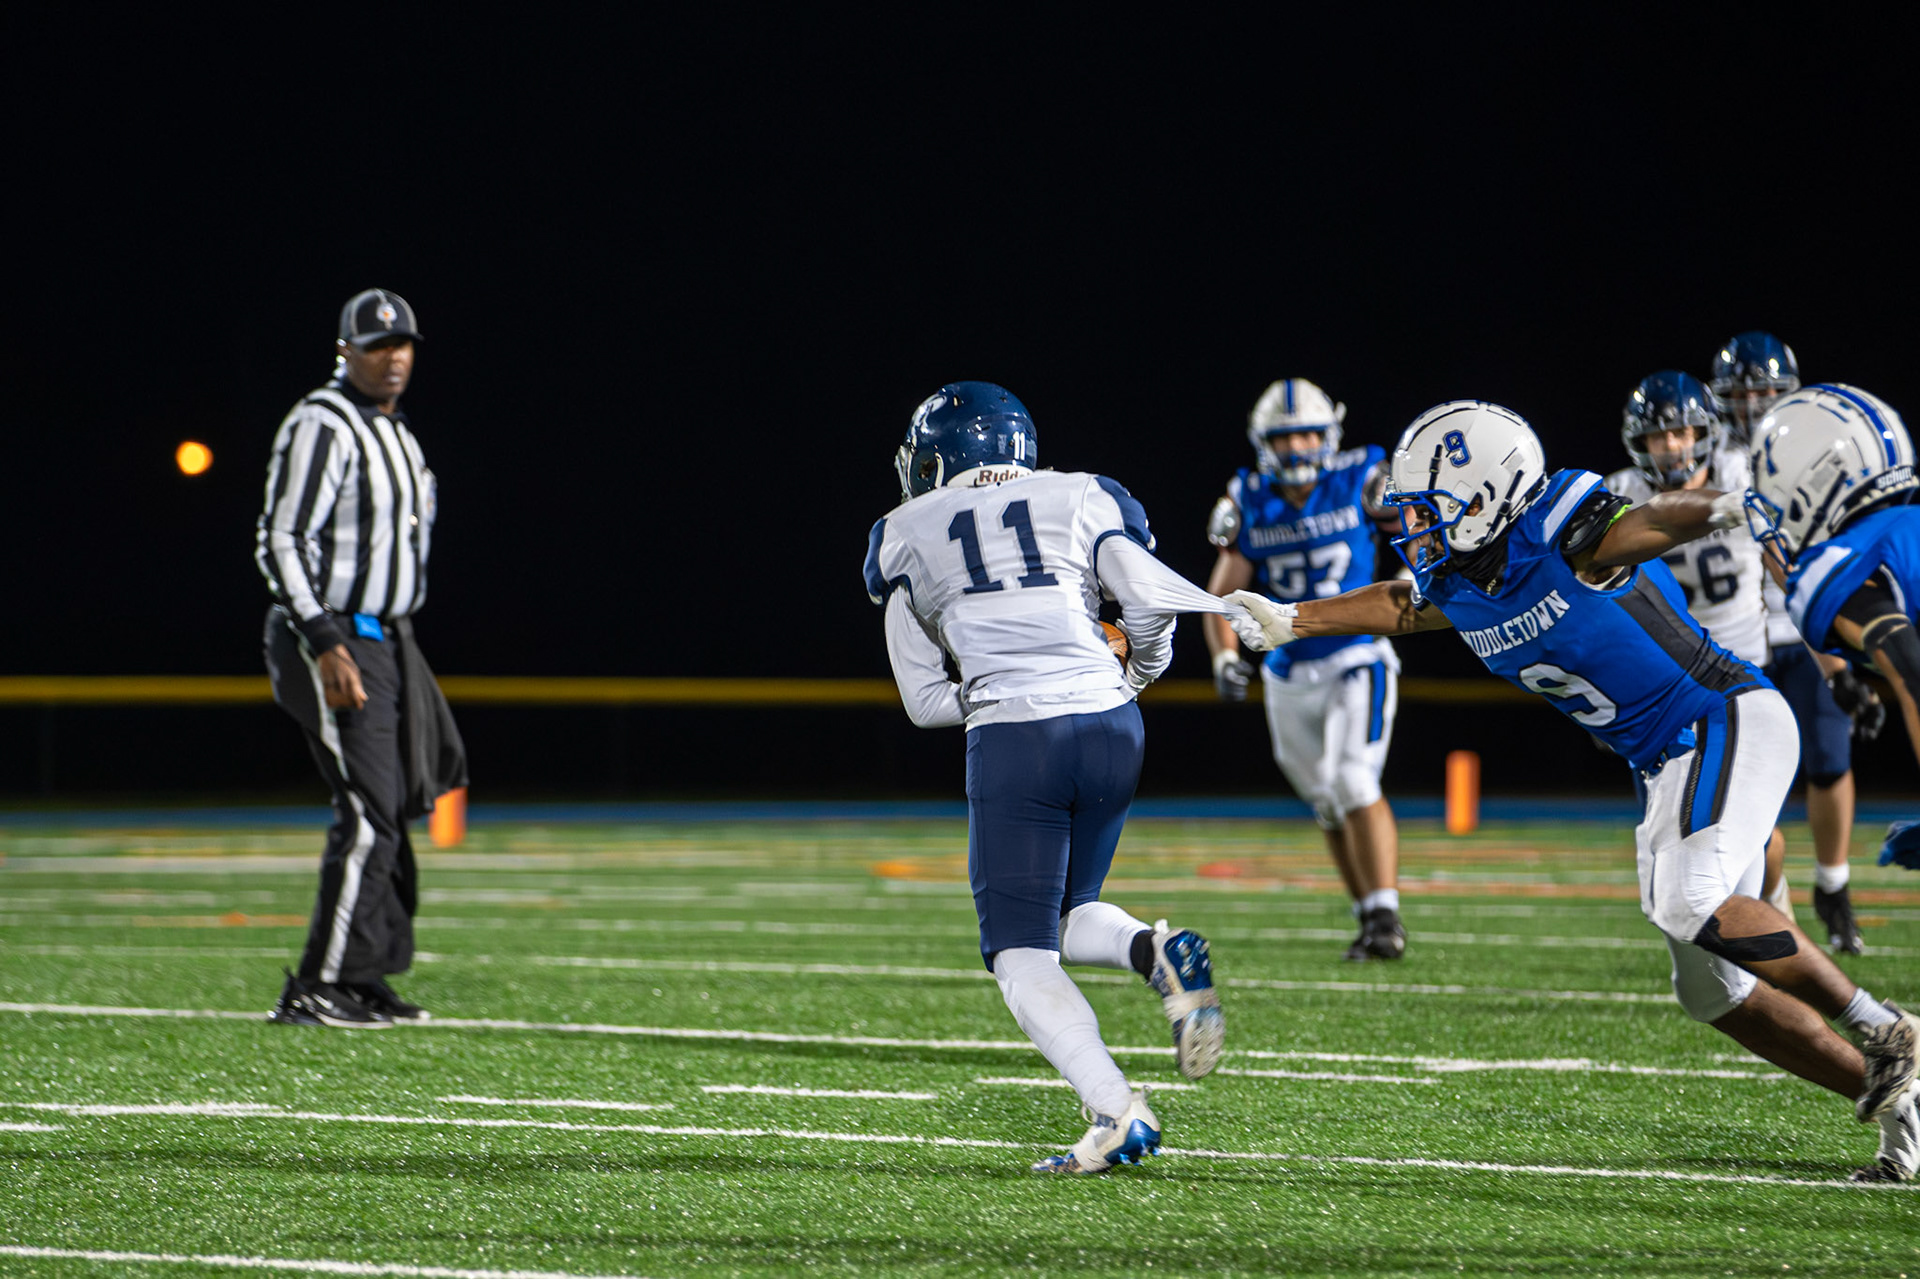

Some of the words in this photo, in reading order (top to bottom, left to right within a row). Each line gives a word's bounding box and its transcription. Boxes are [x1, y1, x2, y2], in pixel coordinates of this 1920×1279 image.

[979, 469, 1030, 482] Ridd
[1012, 431, 1026, 460] 11
[1442, 429, 1472, 468] 9
[948, 498, 1059, 593] 11
[1266, 540, 1353, 600] 57
[1459, 589, 1571, 658] MIDDLETOWN
[1519, 662, 1617, 727] 9
